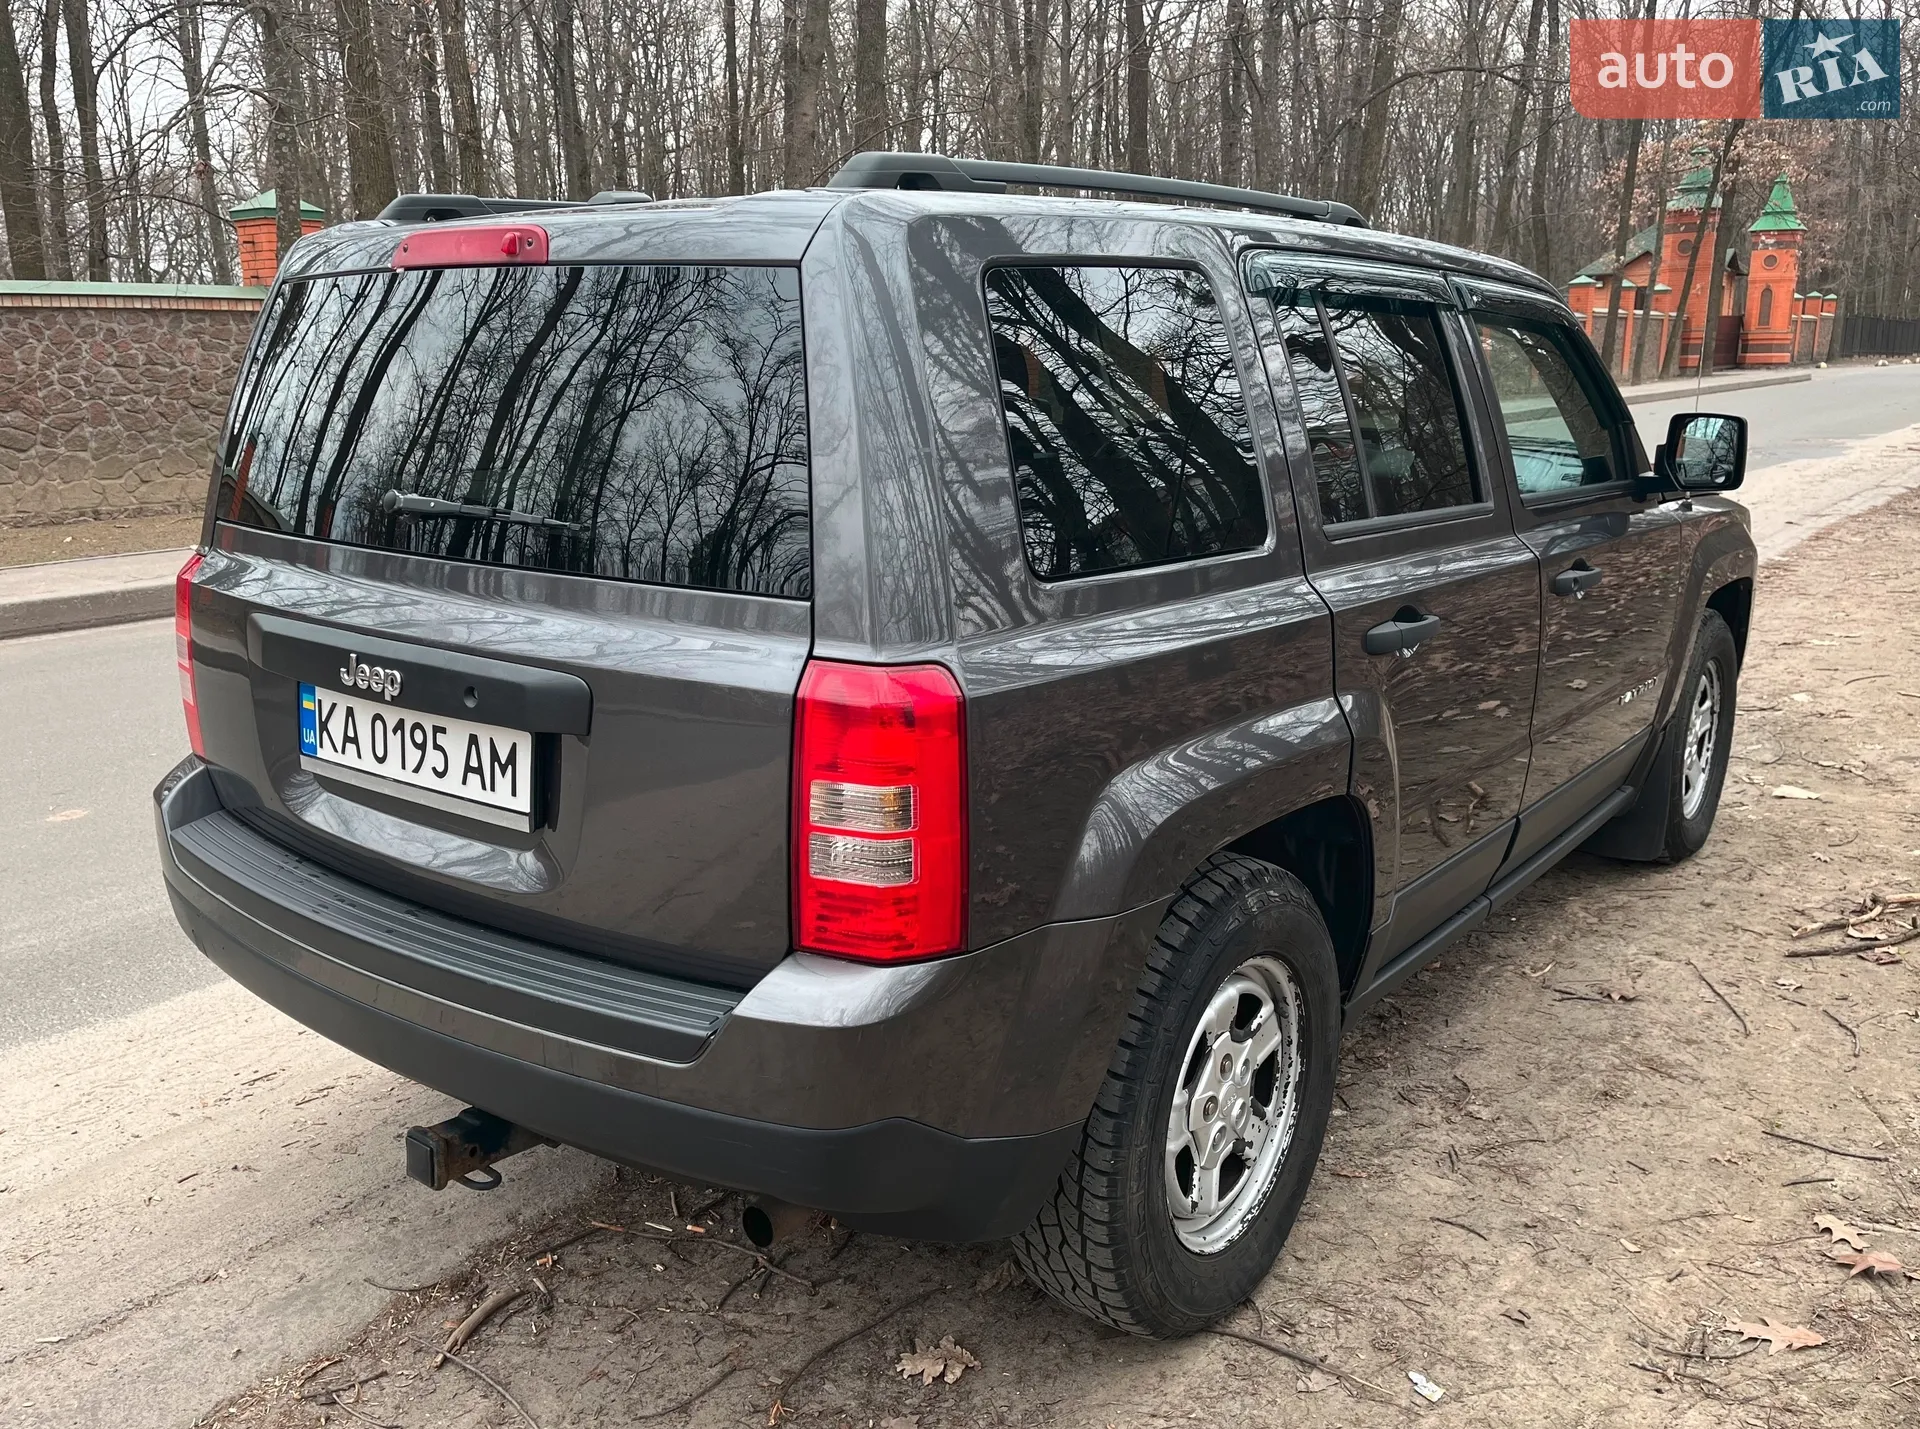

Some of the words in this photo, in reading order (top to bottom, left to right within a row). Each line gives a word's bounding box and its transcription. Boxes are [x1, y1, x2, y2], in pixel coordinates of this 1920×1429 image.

[340, 653, 403, 702] Jeep
[302, 728, 316, 746] UA
[317, 698, 362, 760] KA
[370, 712, 449, 779] 0195
[461, 732, 517, 798] AM
